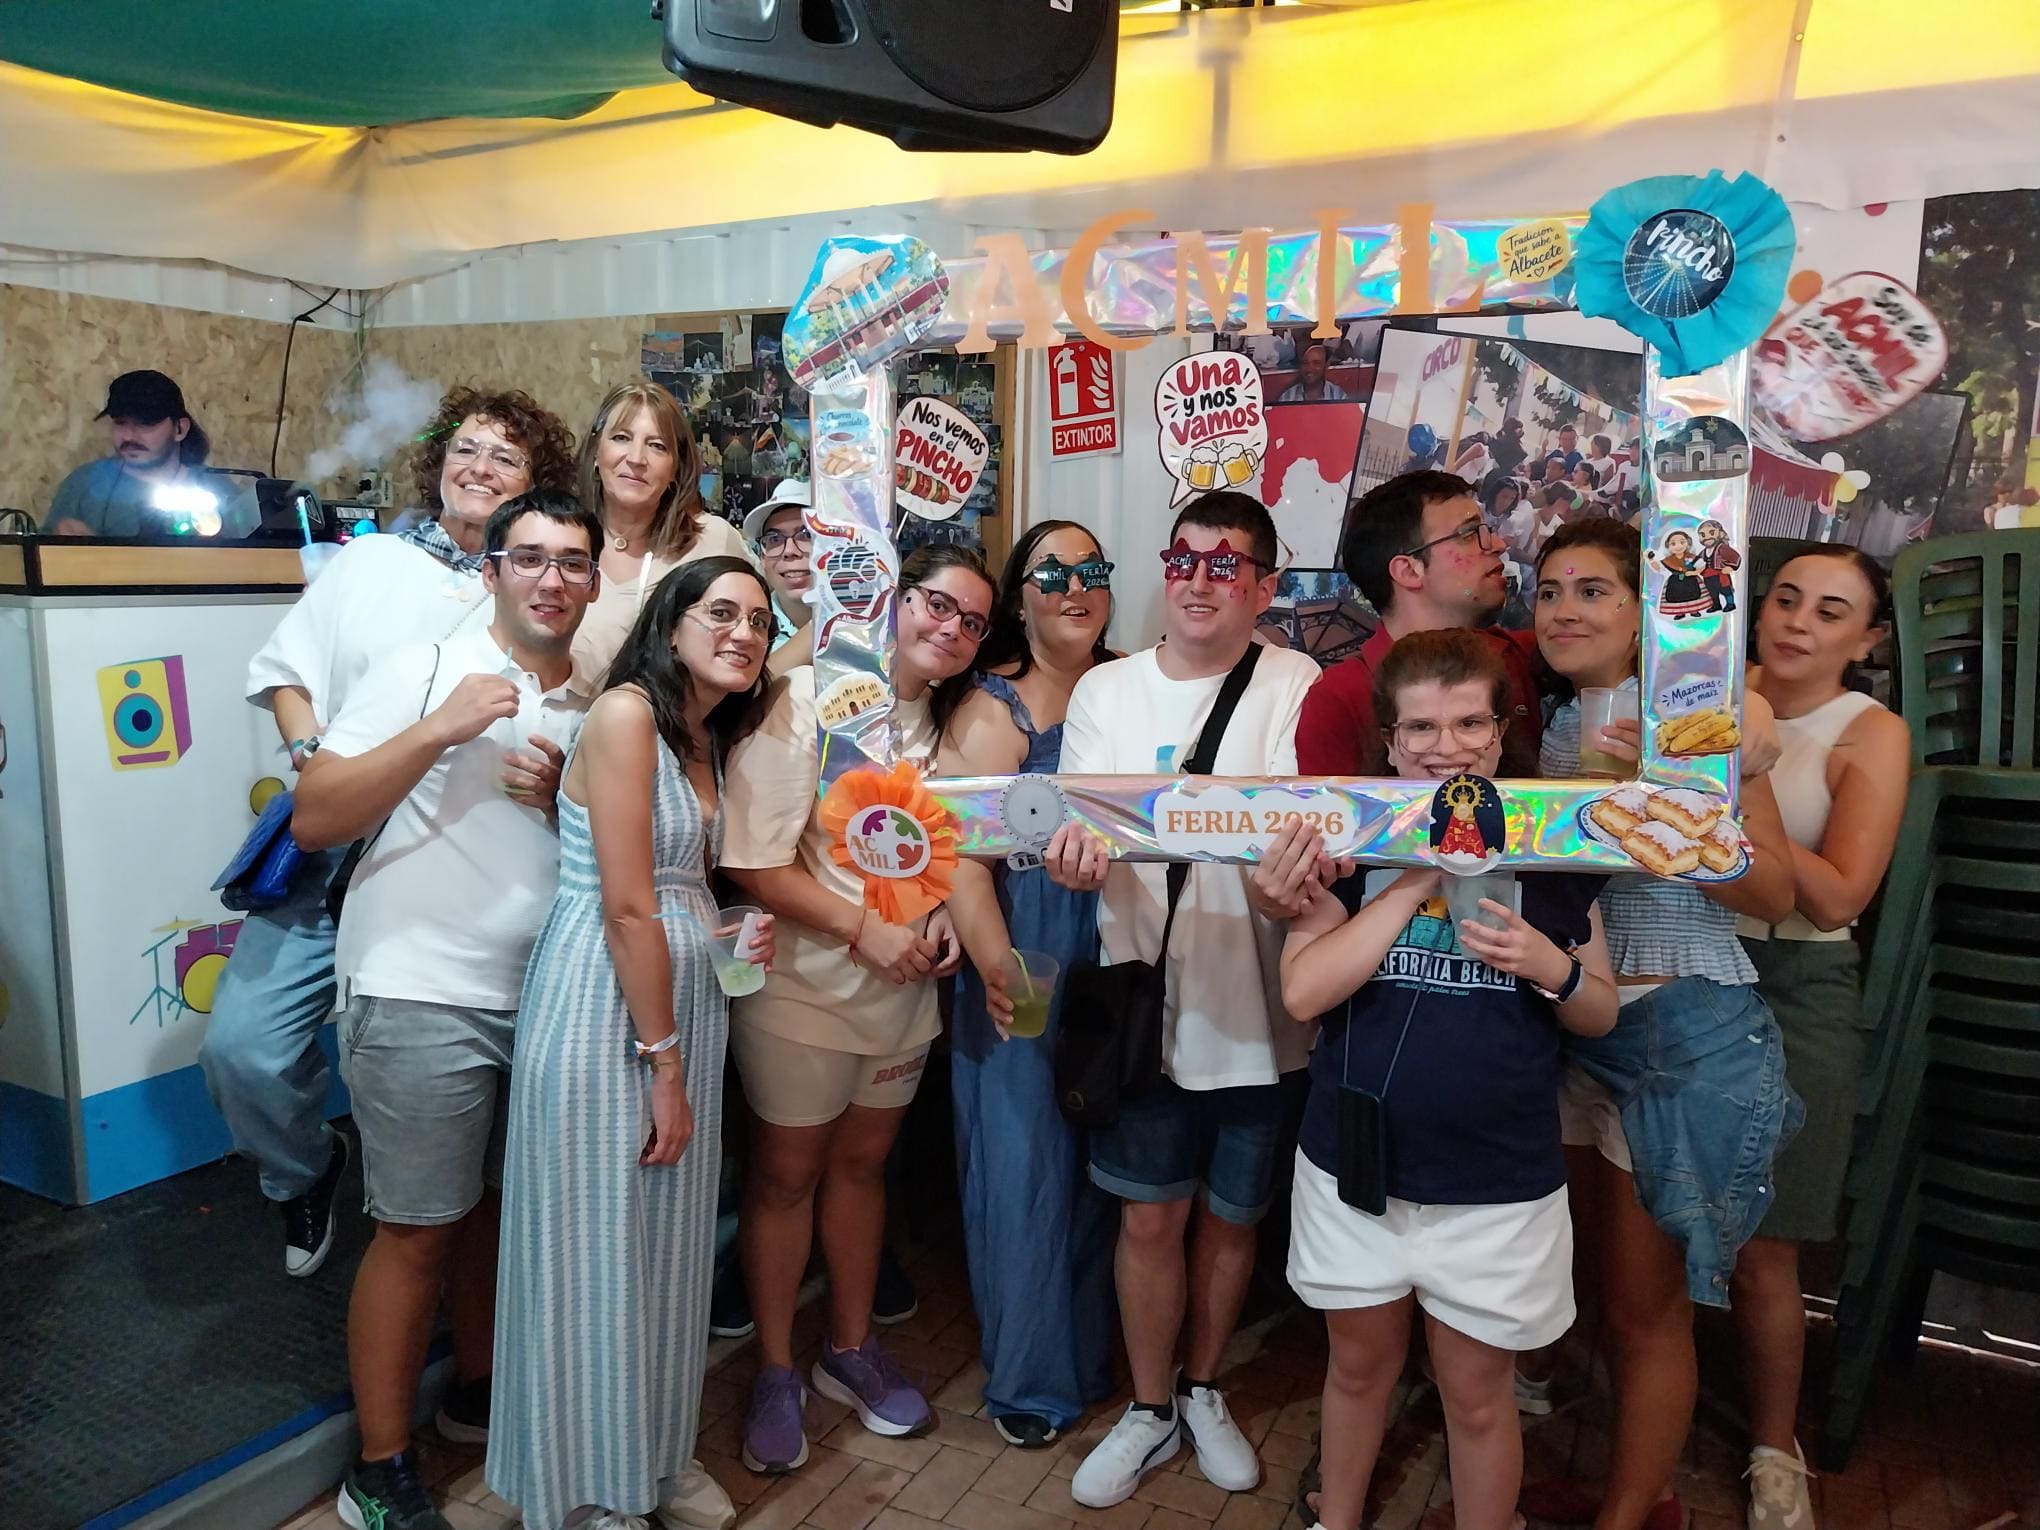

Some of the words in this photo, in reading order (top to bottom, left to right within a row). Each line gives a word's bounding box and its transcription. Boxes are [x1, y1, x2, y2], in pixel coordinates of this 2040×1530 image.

[1515, 246, 1528, 259] que
[1532, 236, 1551, 250] sabe
[1510, 244, 1563, 278] Albacete
[955, 203, 1482, 354] ACMIL
[1176, 358, 1242, 396] Una
[1183, 397, 1195, 417] y
[1200, 387, 1237, 411] nos
[912, 401, 941, 427] Nos
[944, 418, 985, 456] vemos
[1055, 424, 1113, 450] EXTINTOR
[1170, 403, 1260, 446] vamos
[929, 431, 944, 445] en
[945, 440, 959, 454] el
[895, 428, 973, 494] PINCHO
[1211, 554, 1237, 566] FERIA
[1671, 680, 1716, 704] Mazorcas
[1685, 698, 1695, 707] de
[1167, 810, 1258, 834] FERIA
[850, 834, 878, 852] AC
[858, 850, 896, 870] MIL
[1372, 951, 1452, 981] LIFORNIA
